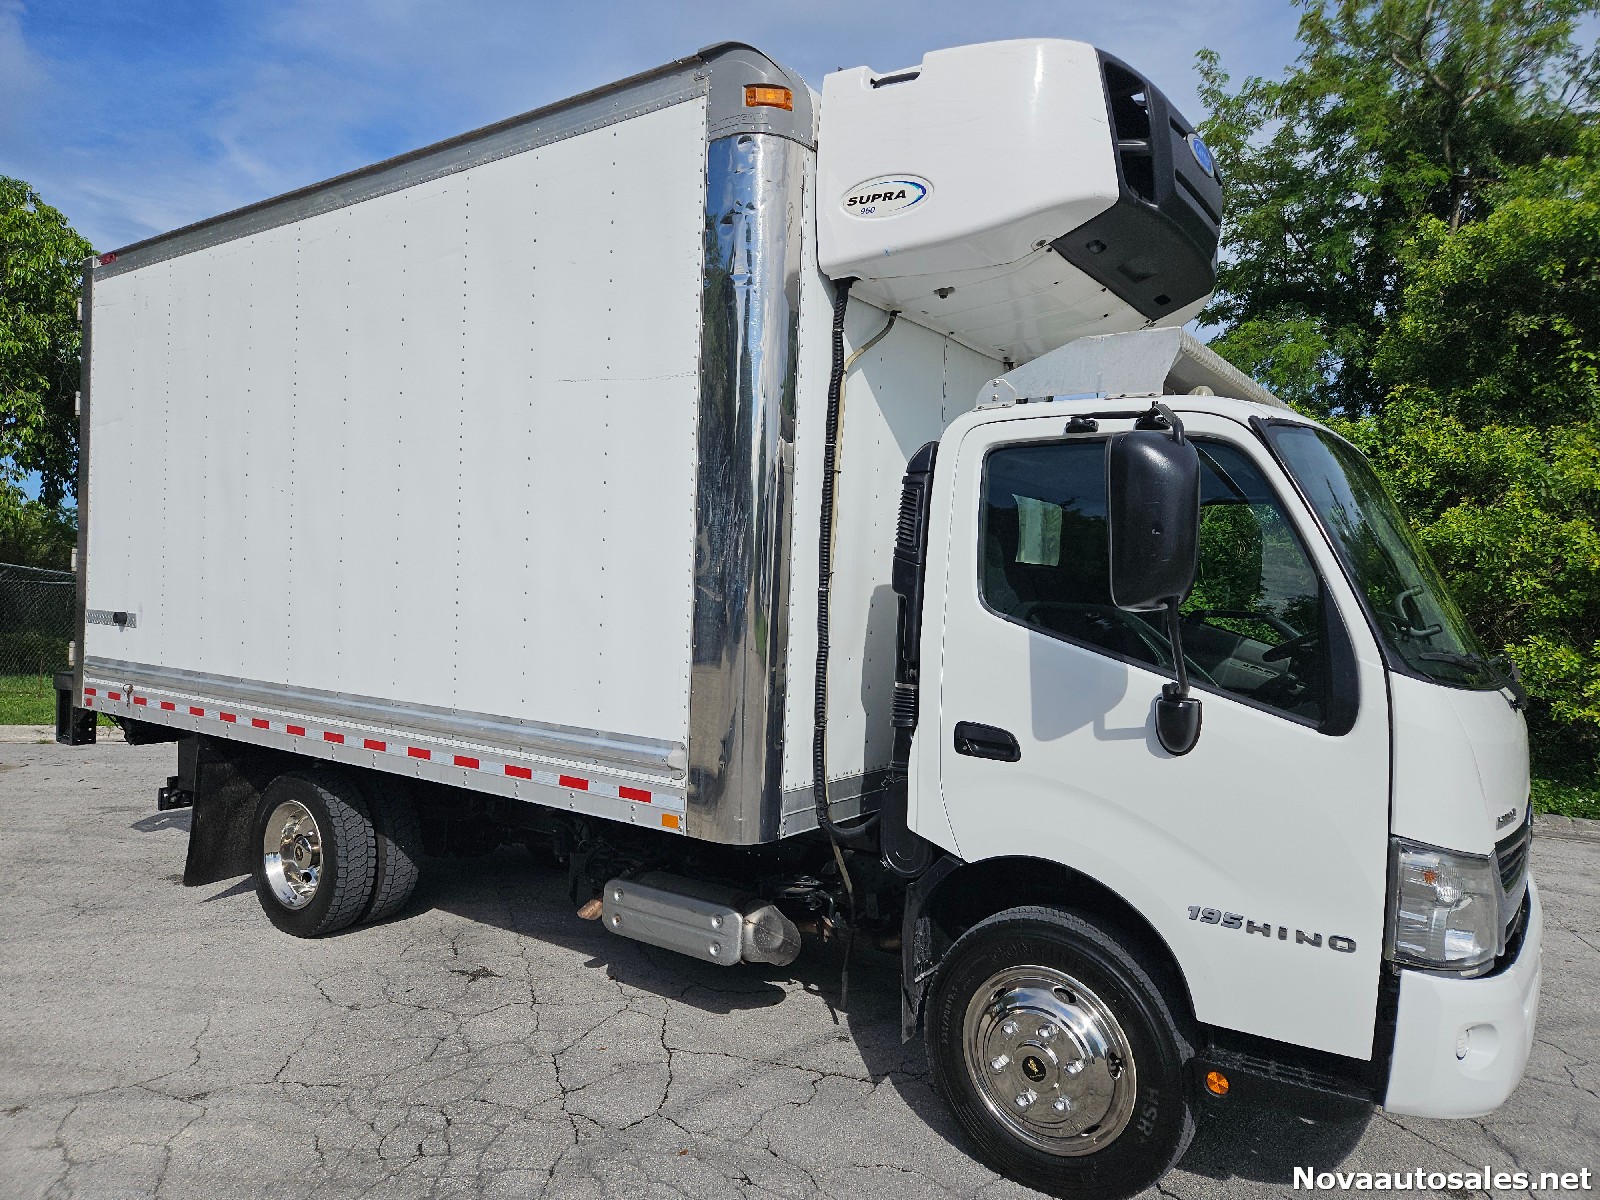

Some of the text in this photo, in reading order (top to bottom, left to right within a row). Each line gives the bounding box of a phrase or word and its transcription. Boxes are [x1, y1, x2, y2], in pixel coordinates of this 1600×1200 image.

[847, 190, 907, 207] SUPRA
[1187, 905, 1357, 954] 195 HINO
